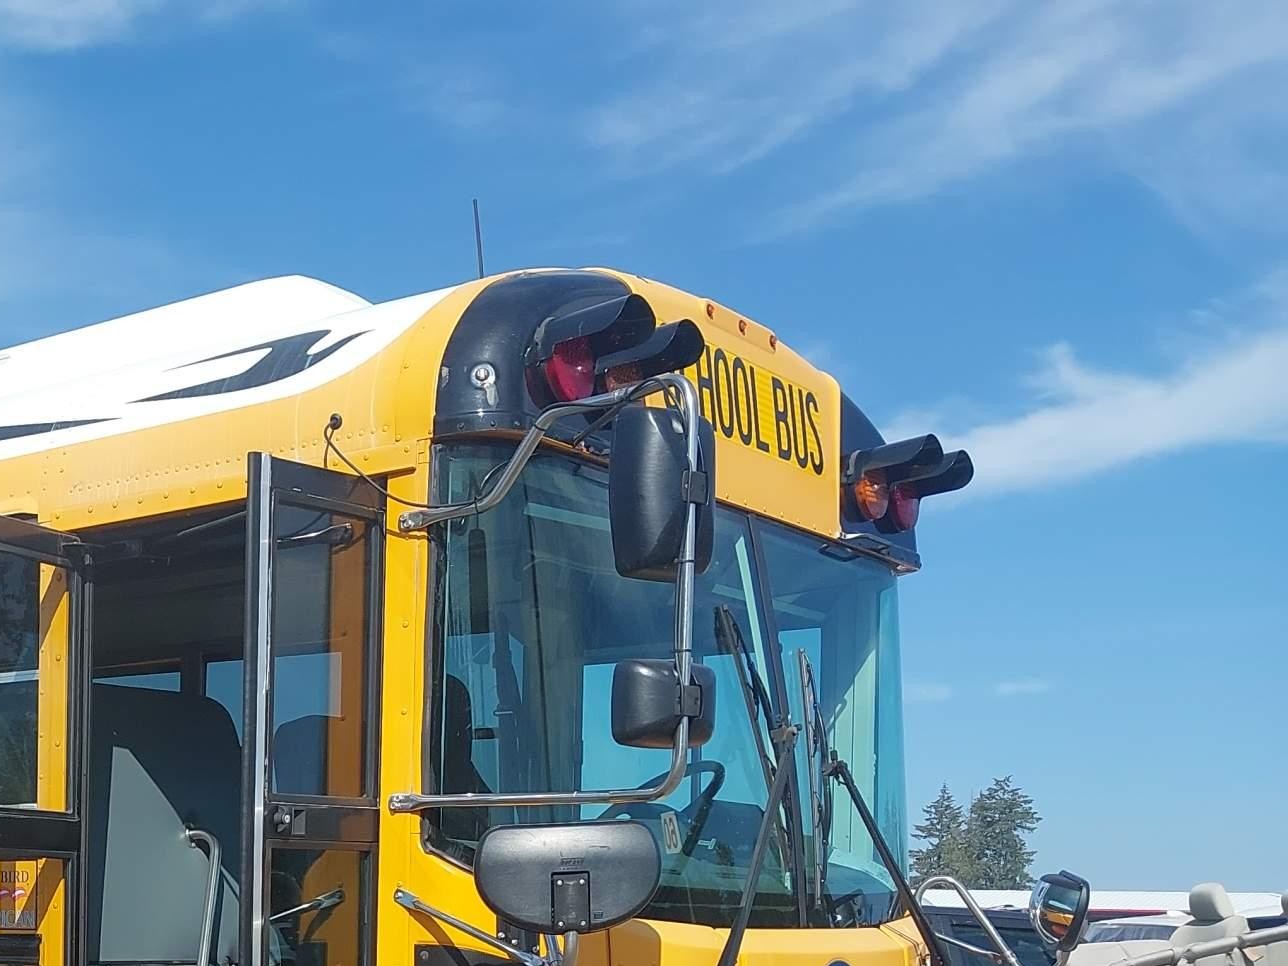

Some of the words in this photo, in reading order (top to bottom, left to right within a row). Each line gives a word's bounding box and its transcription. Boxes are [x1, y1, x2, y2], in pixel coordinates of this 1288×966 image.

[678, 344, 770, 453] HOOL
[772, 376, 824, 475] BUS
[1, 870, 29, 885] BIRD
